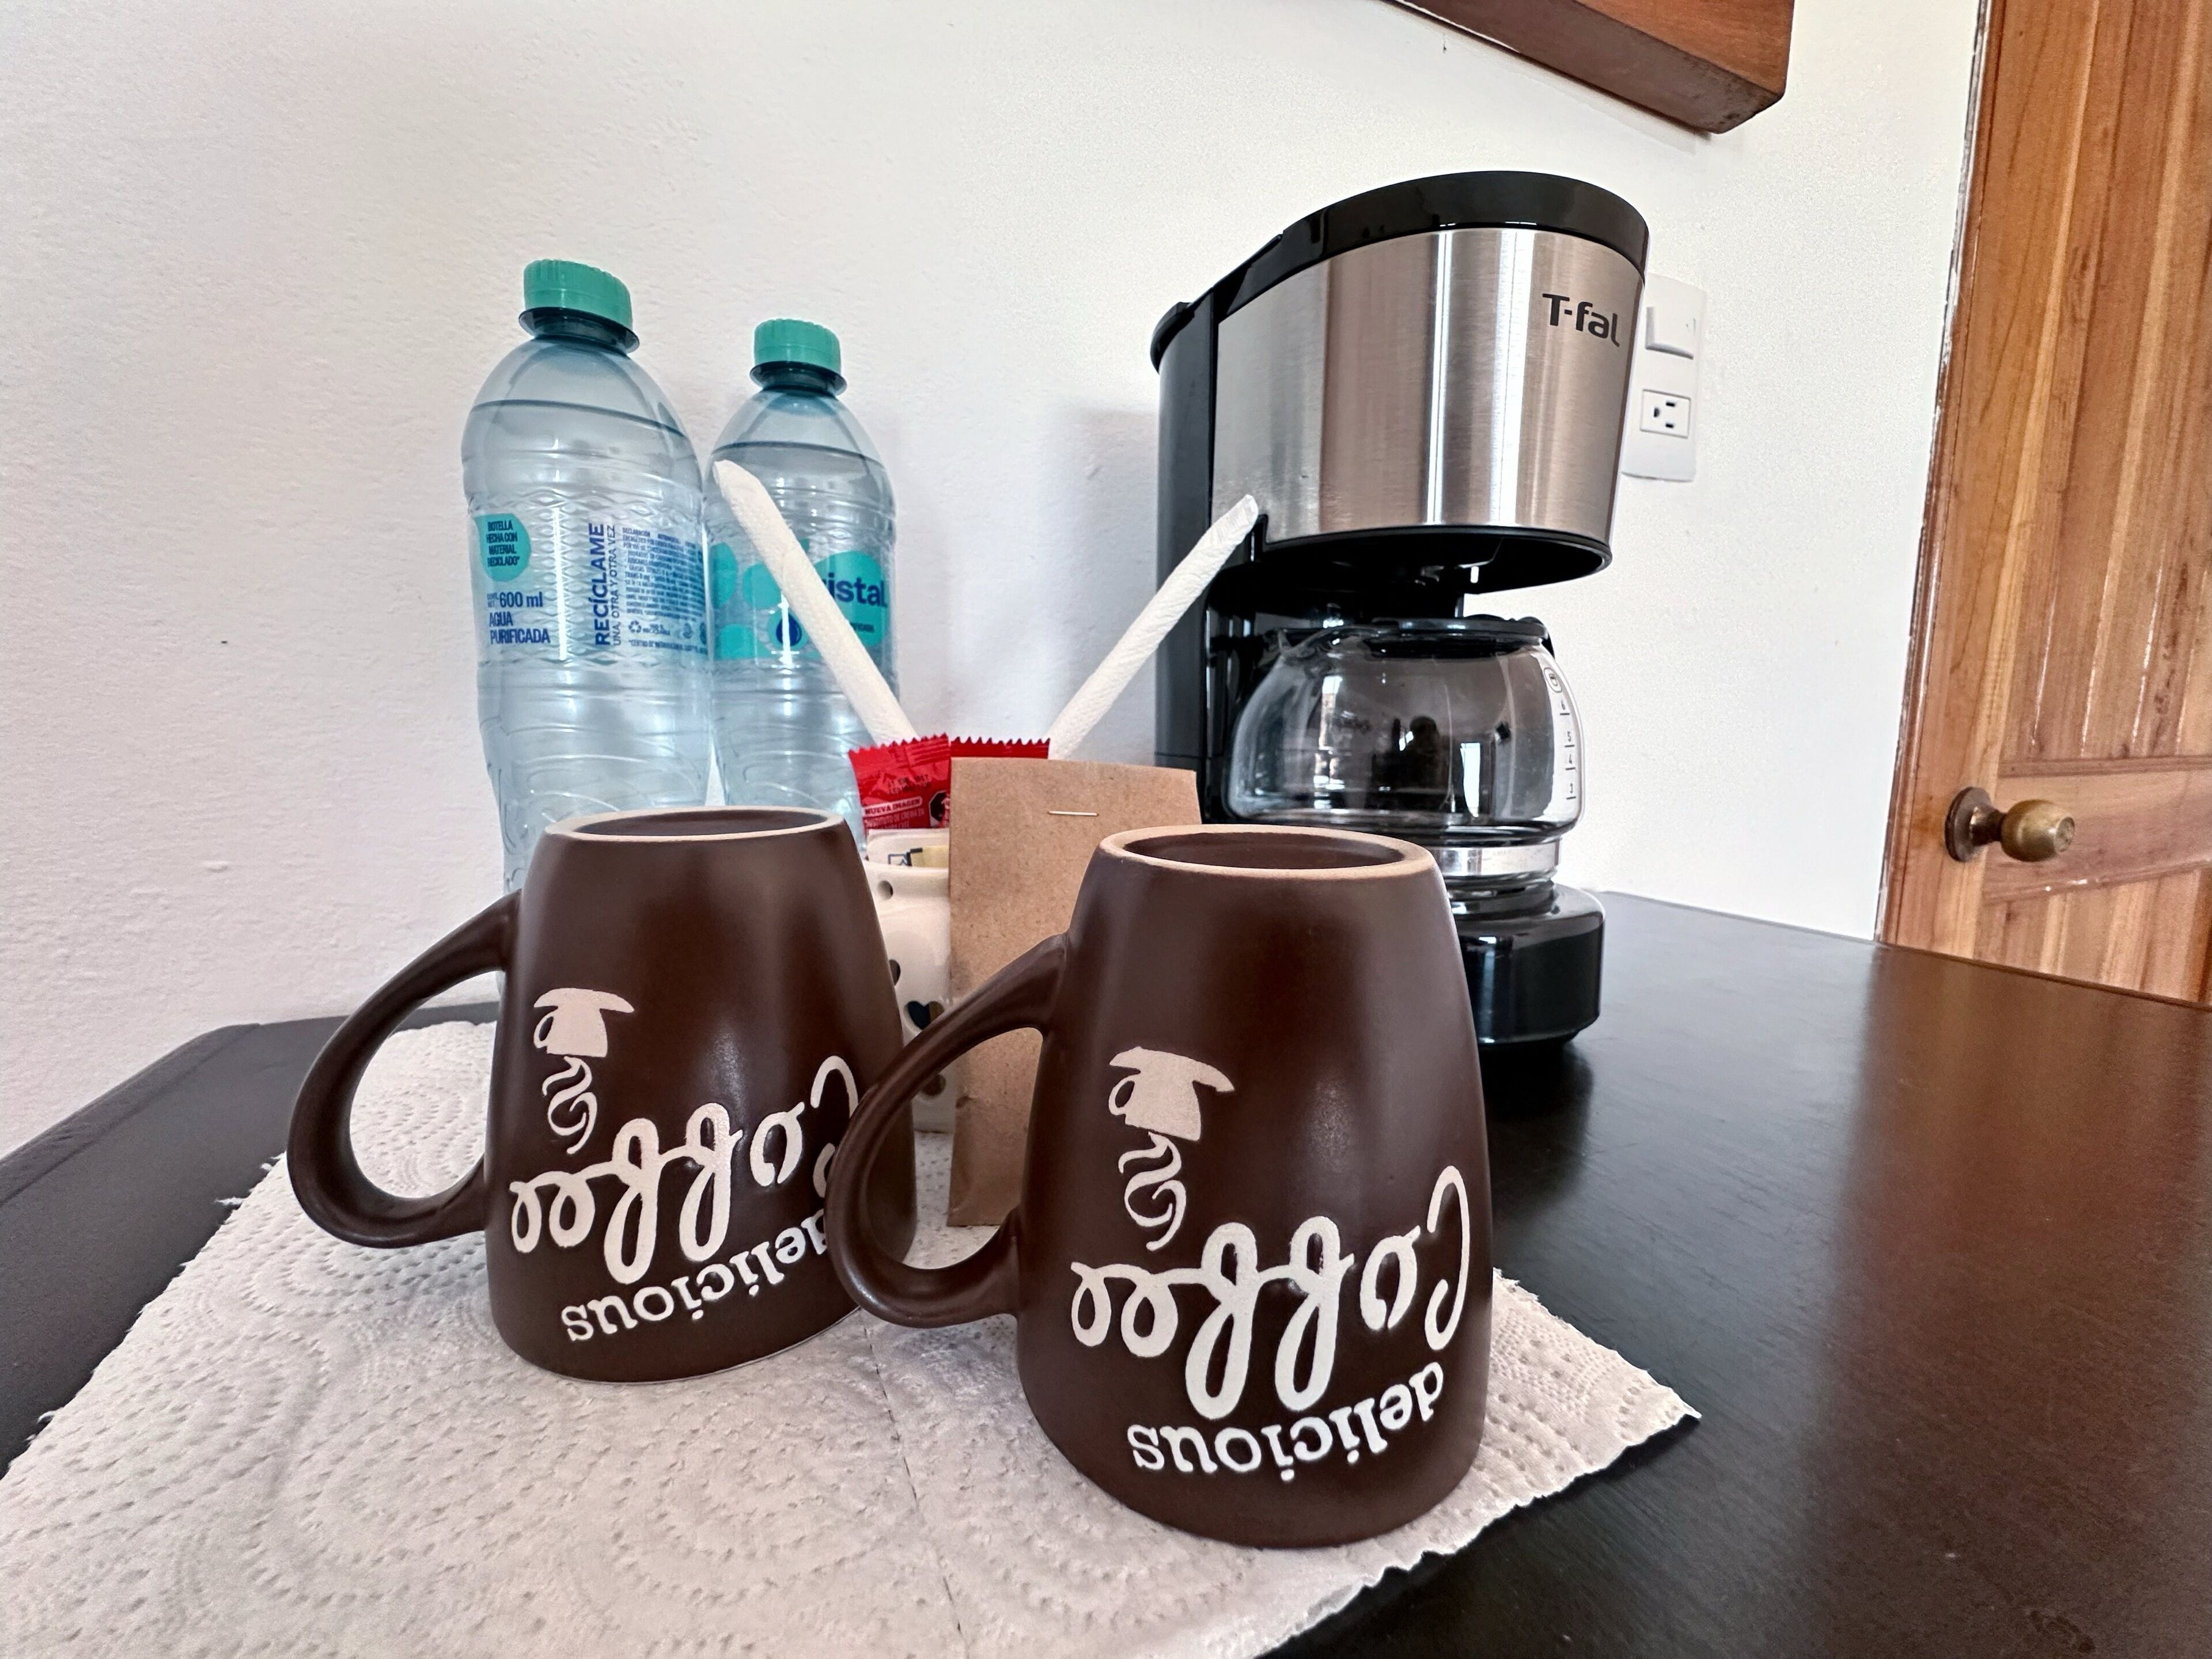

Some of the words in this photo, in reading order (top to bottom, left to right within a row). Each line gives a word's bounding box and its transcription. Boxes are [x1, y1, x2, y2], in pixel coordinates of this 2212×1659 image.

[1542, 293, 1620, 347] T-fal
[487, 520, 513, 531] BOTELLA
[607, 525, 616, 546] VEZ
[486, 533, 504, 544] HECHA
[505, 532, 518, 542] CON
[488, 544, 517, 555] MATERIAL
[608, 548, 618, 577] OTRA
[588, 522, 611, 646] RECÍCLAME
[822, 572, 887, 608] istal
[500, 591, 523, 607] 600
[527, 591, 543, 607] ml
[611, 589, 620, 619] OTRA
[489, 611, 514, 627] AGUA
[490, 628, 551, 645] PURIFICADA
[865, 805, 891, 815] NUEVA
[892, 799, 920, 809] IMAGEN
[1070, 1165, 1471, 1420] Coffee
[1127, 1362, 1444, 1482] delicious
